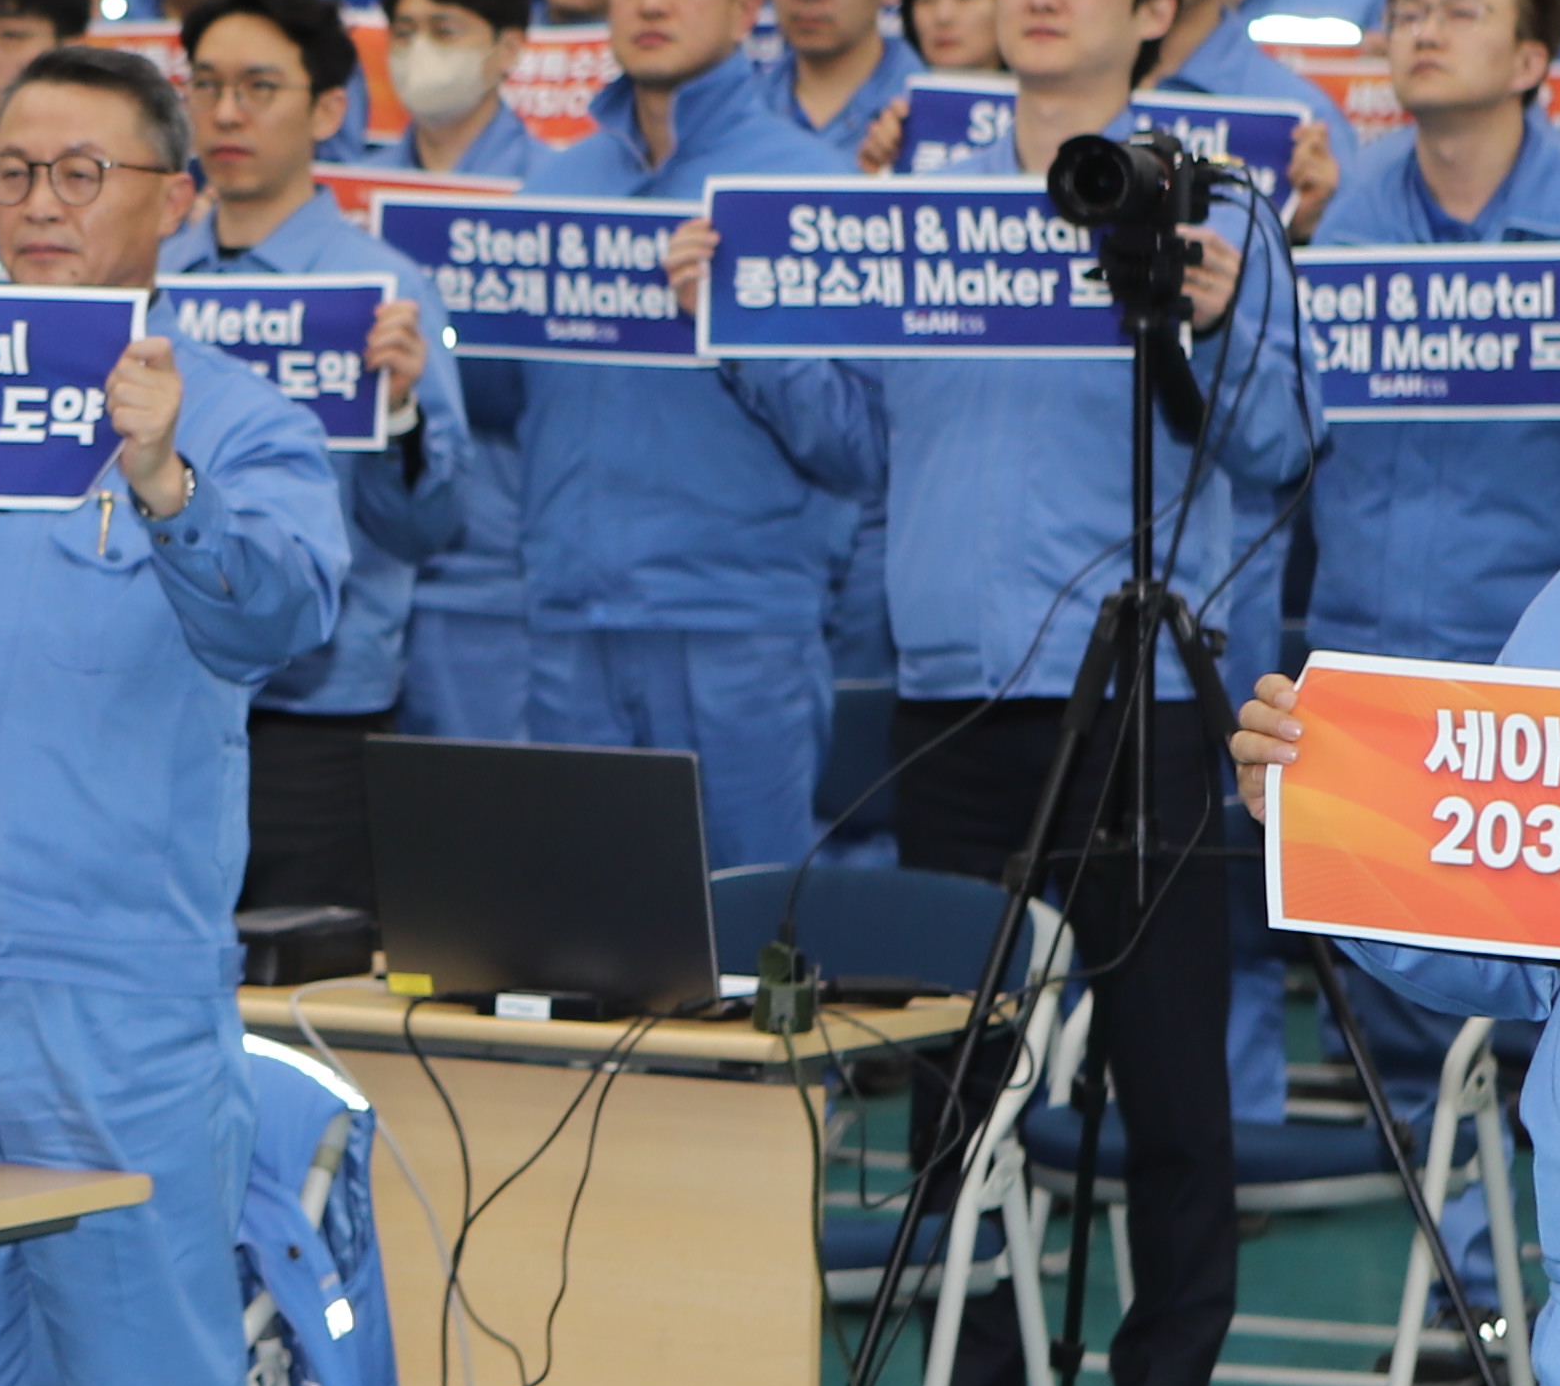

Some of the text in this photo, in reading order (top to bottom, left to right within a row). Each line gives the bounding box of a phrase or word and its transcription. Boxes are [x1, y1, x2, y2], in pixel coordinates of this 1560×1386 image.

[449, 218, 671, 272] Steel & Met
[787, 204, 905, 254] Steel
[914, 206, 949, 254] &
[422, 265, 547, 316] 합소재
[734, 256, 904, 309] 종합소재
[914, 259, 1060, 307] Maker
[1298, 271, 1555, 322] teel & Metal
[179, 299, 305, 346] Metal
[1381, 324, 1520, 372] Maker
[277, 350, 362, 401] 도약
